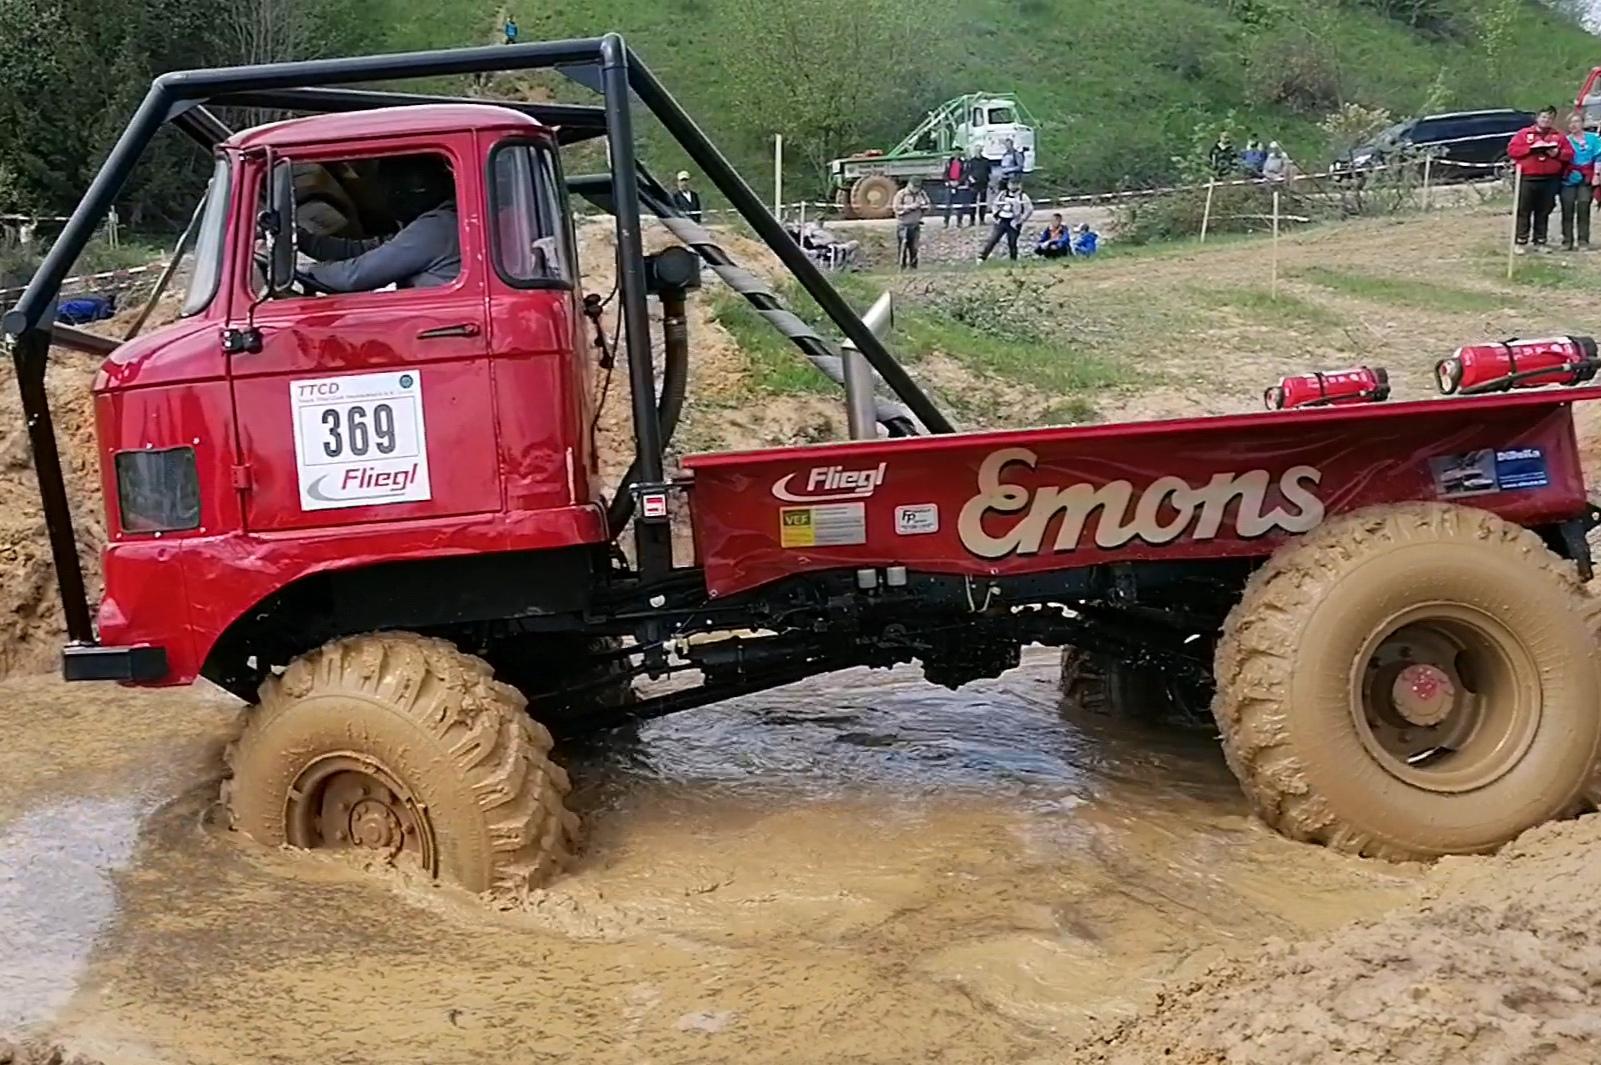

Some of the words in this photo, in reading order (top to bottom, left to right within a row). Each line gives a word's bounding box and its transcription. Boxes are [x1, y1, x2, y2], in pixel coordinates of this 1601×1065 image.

[298, 382, 340, 397] TTCD
[321, 403, 396, 458] 369
[341, 463, 419, 492] Fliegl
[806, 462, 888, 493] Fliegl
[957, 447, 1326, 559] Emons
